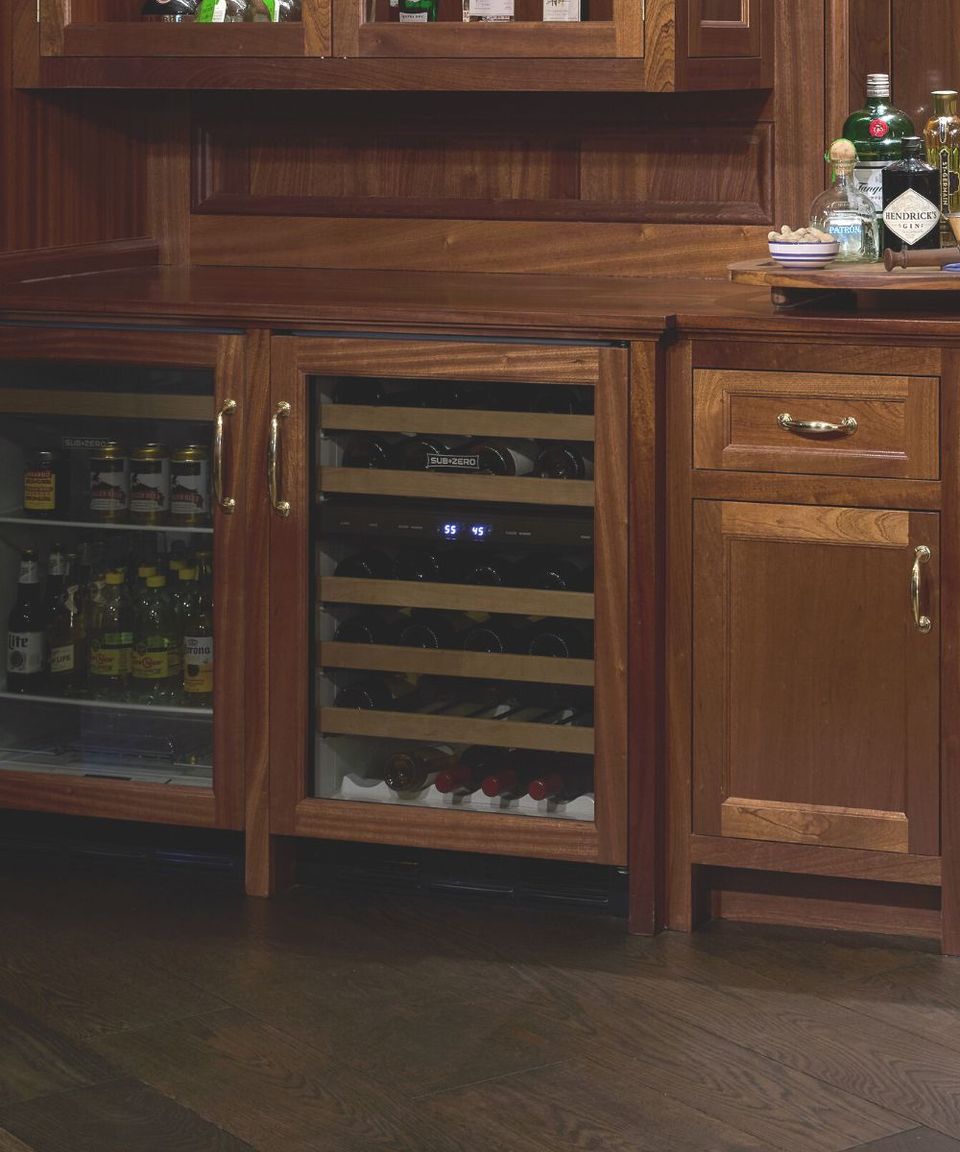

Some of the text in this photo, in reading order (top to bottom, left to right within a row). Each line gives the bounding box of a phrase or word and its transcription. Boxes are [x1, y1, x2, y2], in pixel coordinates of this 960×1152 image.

[885, 211, 937, 221] HENDRICK'S
[444, 524, 484, 536] 55 45
